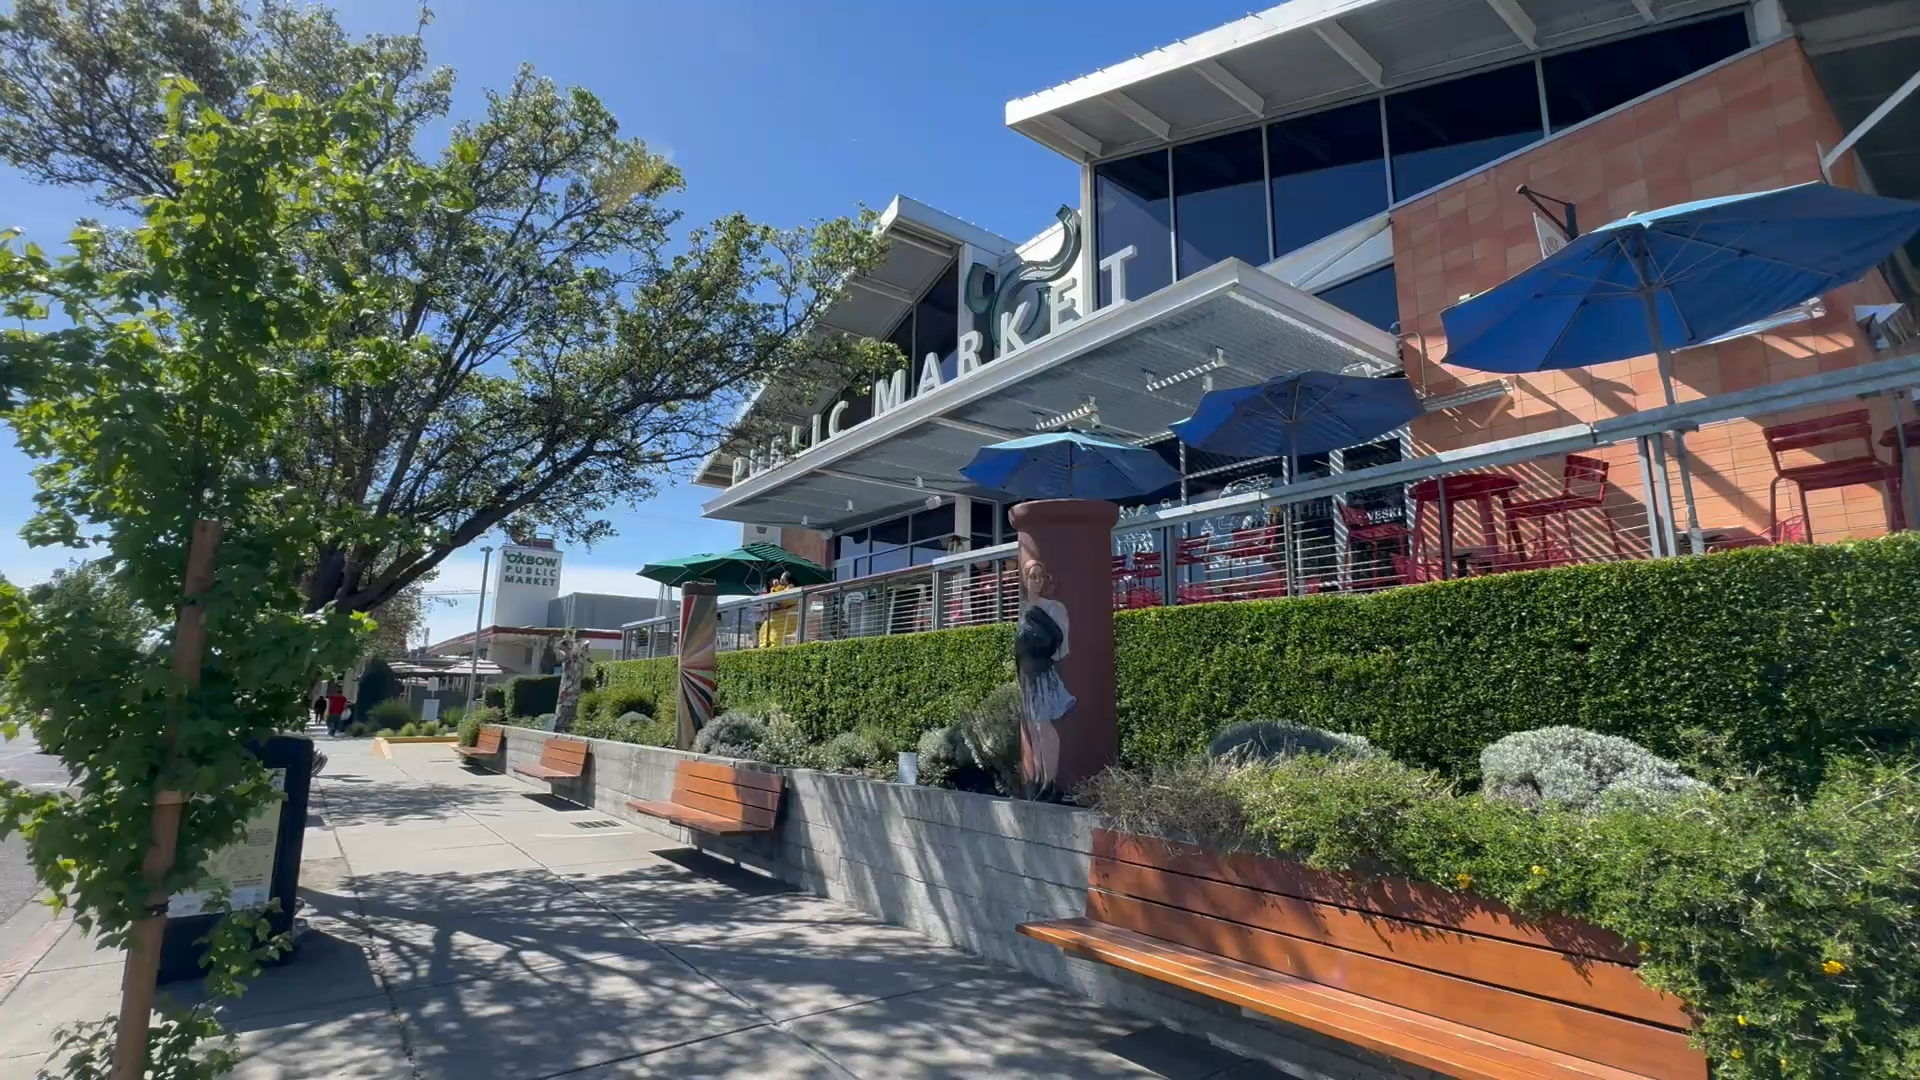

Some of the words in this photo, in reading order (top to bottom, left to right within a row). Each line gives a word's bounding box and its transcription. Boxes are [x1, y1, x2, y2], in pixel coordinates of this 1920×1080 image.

[873, 244, 1138, 418] MARKET
[504, 550, 557, 567] OXBOW
[506, 565, 556, 577] PUBLIC
[504, 575, 556, 586] MARKET
